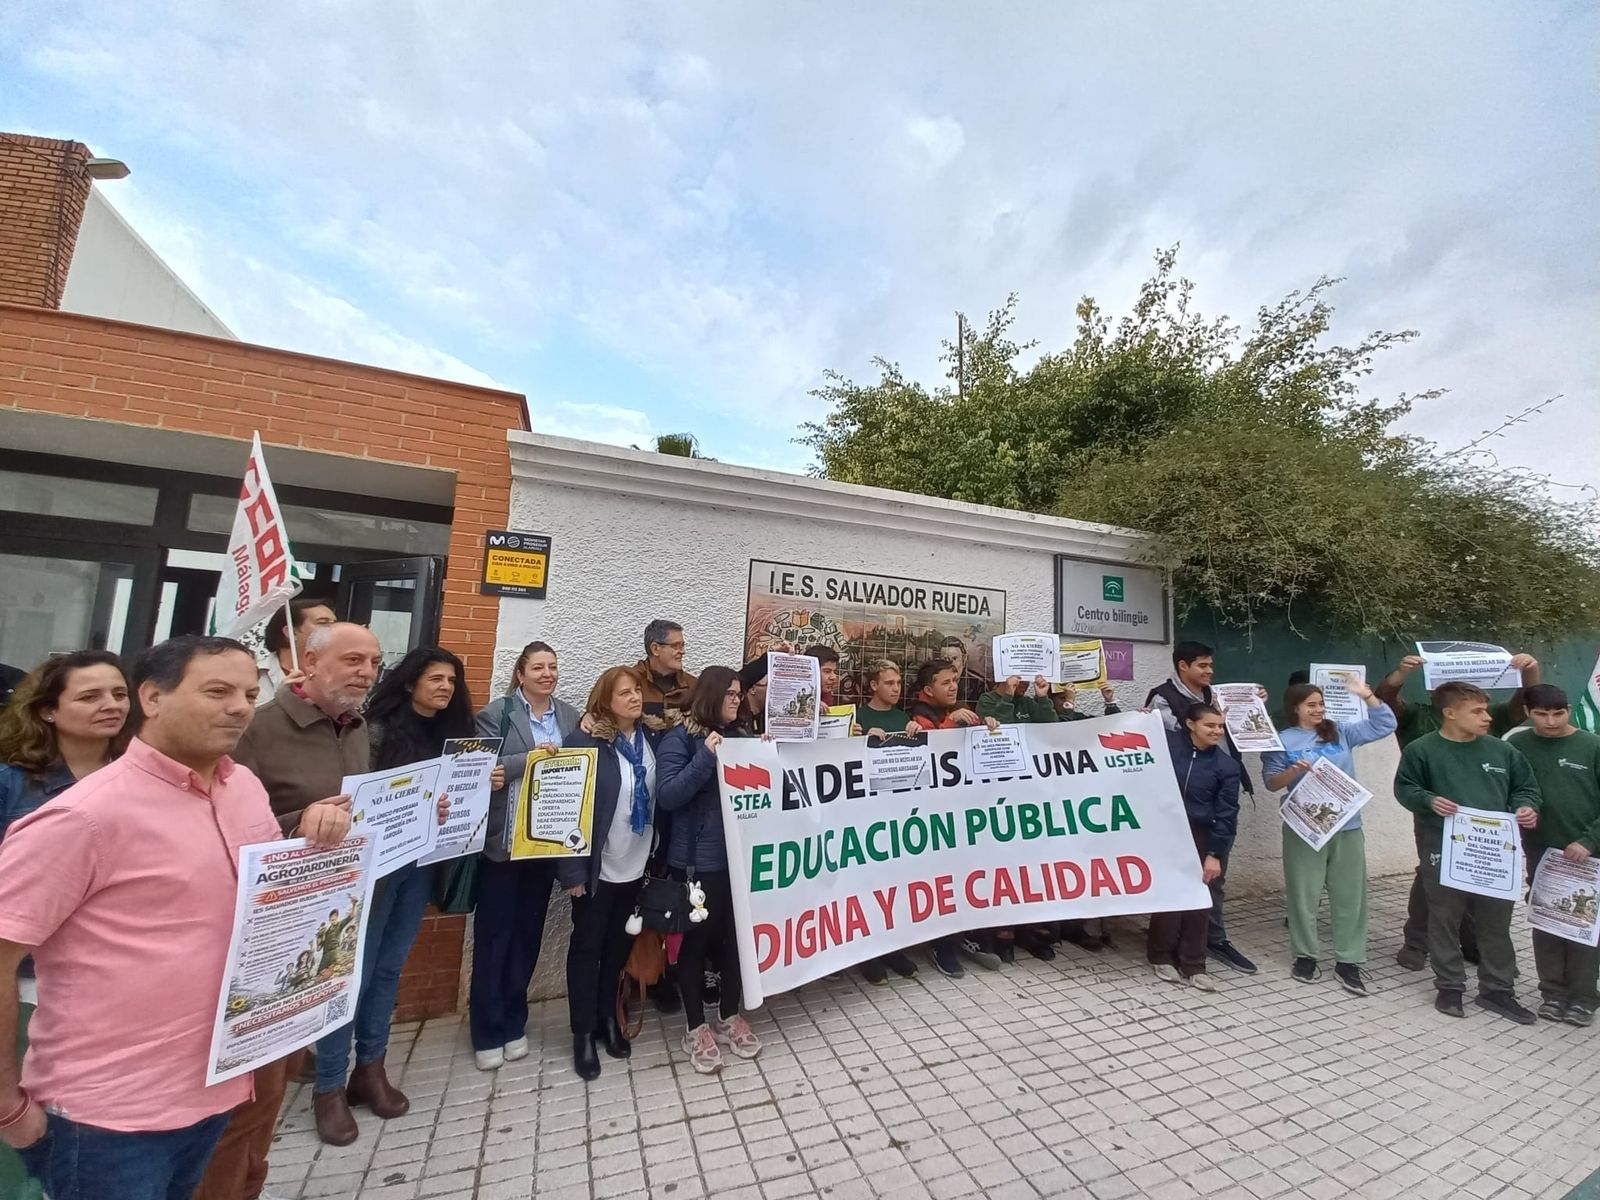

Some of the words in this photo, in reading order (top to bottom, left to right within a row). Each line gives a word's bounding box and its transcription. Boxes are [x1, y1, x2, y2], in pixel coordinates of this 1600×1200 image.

[492, 555, 541, 565] CONECTADA
[232, 543, 249, 617] Málag
[769, 571, 819, 598] I.E.S.
[826, 577, 926, 610] SALVADOR
[932, 590, 991, 617] RUEDA
[1078, 606, 1110, 622] Centro
[1112, 609, 1149, 626] bilingüe
[1032, 749, 1099, 778] UNA
[1104, 752, 1155, 768] USTEA
[451, 770, 473, 779] INCLUIR
[446, 785, 454, 793] ES
[454, 782, 478, 792] MEZCLAR
[371, 797, 382, 807] NO
[383, 794, 393, 803] AL
[394, 785, 420, 800] CIERRE
[454, 797, 464, 805] SIN
[730, 792, 772, 812] STEA
[737, 813, 758, 821] MÁLAGA
[437, 823, 471, 837] ADECUADOS
[1472, 826, 1486, 834] NO
[750, 807, 957, 893] EDUCACIÓN
[965, 794, 1141, 846] PÚBLICA
[1468, 835, 1503, 846] CIERRE
[1465, 848, 1501, 857] PROGRAMA
[1480, 844, 1499, 852] ÚNICO
[1464, 852, 1502, 863] ESPECÍFICOS
[256, 854, 360, 885] AGROJARDINERÍA
[267, 860, 301, 871] Programa
[1455, 861, 1508, 874] AGROJARDINERÍA
[1474, 869, 1506, 879] AXARQUÍA
[278, 883, 311, 895] SALVEMOS
[319, 873, 352, 886] PROGRAMA
[265, 899, 299, 911] SALVADOR
[752, 895, 871, 974] DIGNA
[872, 886, 897, 930] Y
[908, 874, 957, 923] DE
[965, 855, 1152, 909] CALIDAD
[250, 1003, 281, 1017] INCLUIR
[303, 981, 332, 996] MEZCLAR
[235, 1002, 301, 1032] ¡NECESITAMOS
[301, 996, 313, 1004] TU
